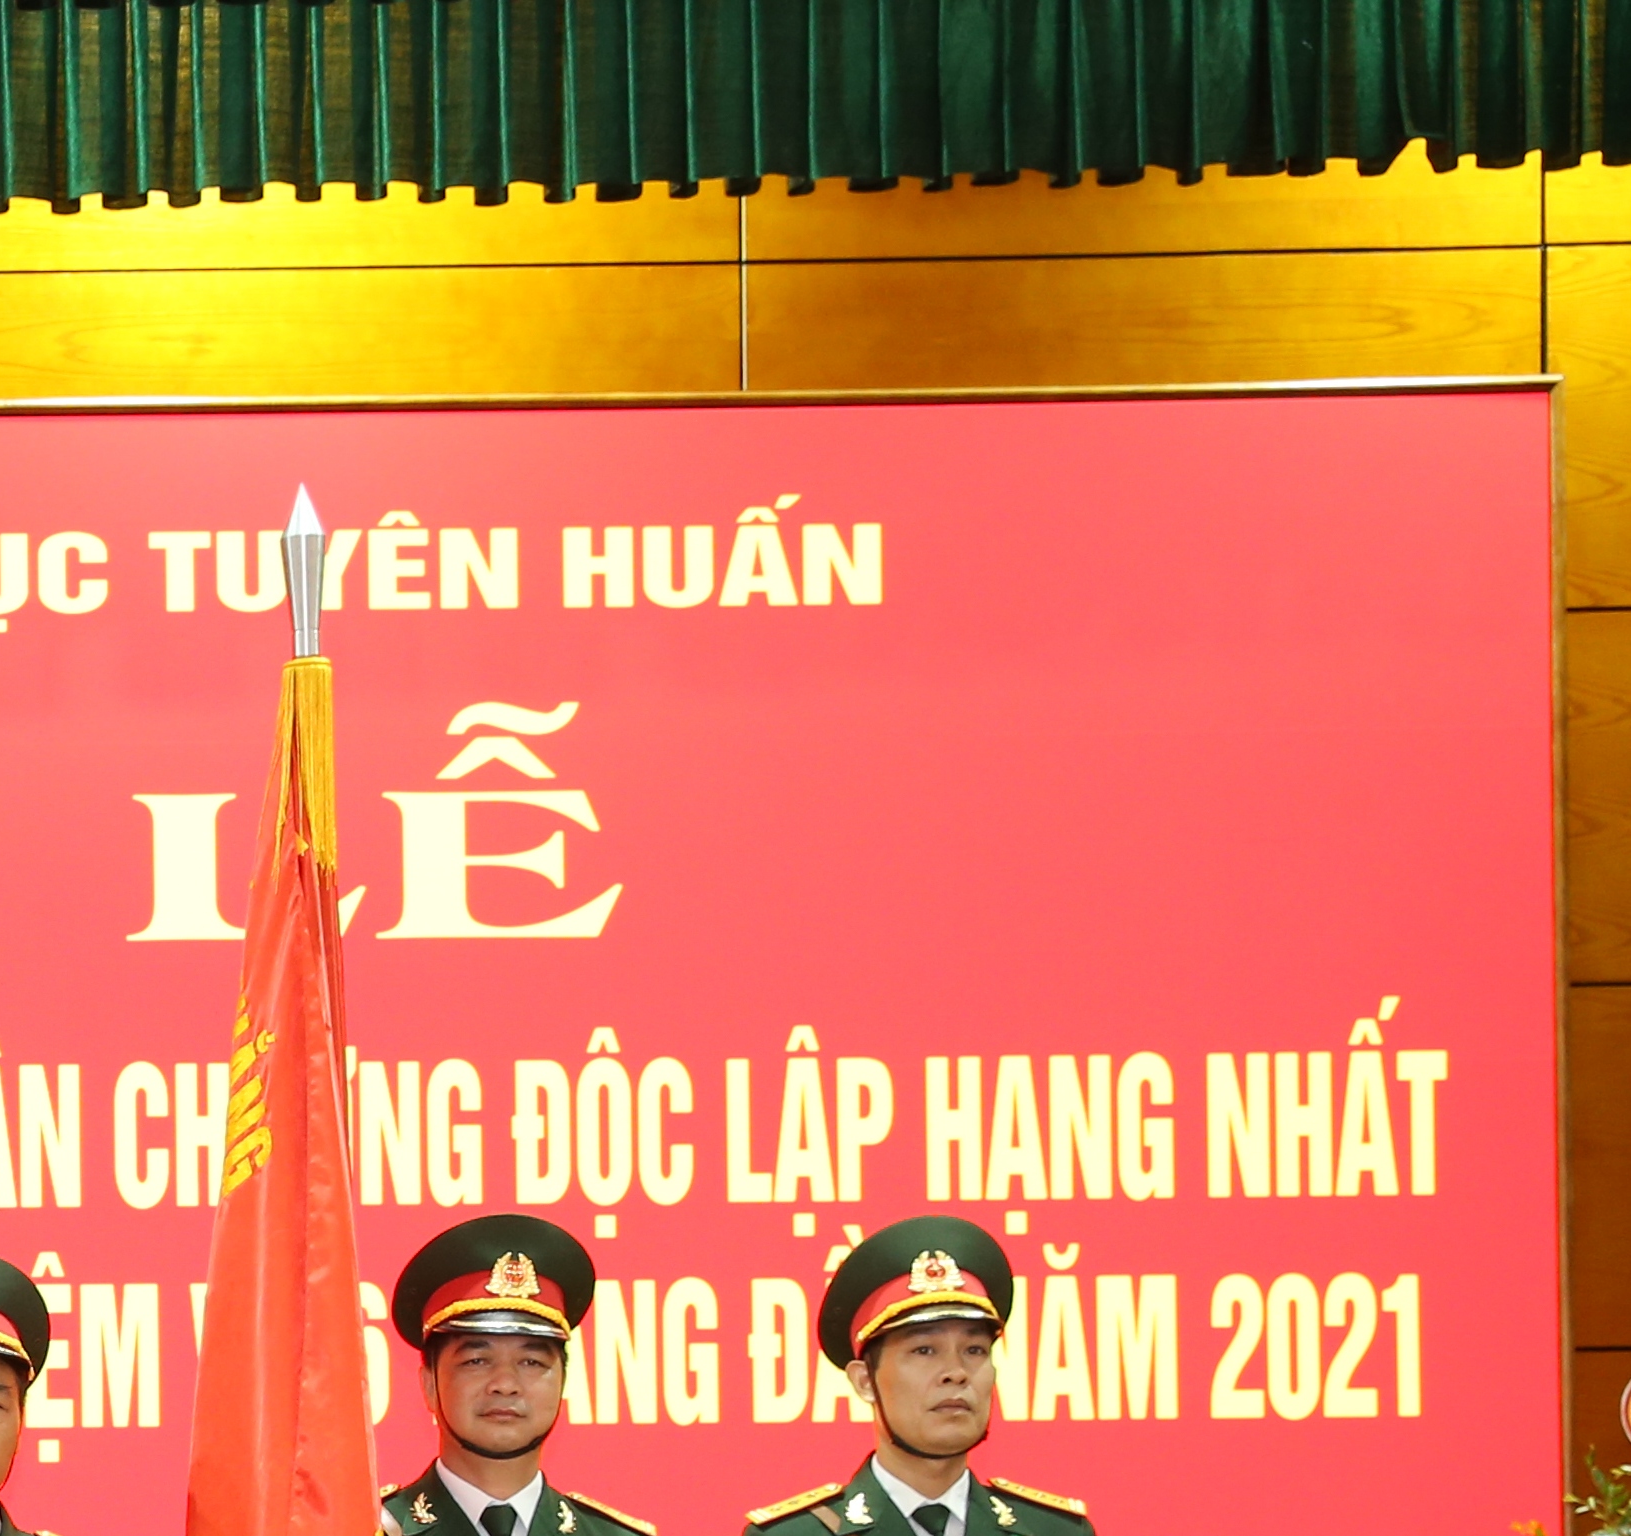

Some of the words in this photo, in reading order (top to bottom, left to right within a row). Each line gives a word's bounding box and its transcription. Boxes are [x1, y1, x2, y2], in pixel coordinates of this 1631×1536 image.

[147, 510, 519, 613] TUYÊN
[562, 494, 882, 609] HUẤN
[125, 701, 624, 941] LỄ
[113, 1045, 483, 1210] CHNG
[511, 1026, 694, 1239] ĐỘC
[725, 1024, 894, 1237] LẬP
[925, 1051, 1175, 1235] HẠNG
[1206, 996, 1448, 1198] NHẤT
[991, 1242, 1179, 1421] NĂM
[1210, 1272, 1422, 1421] 2021
